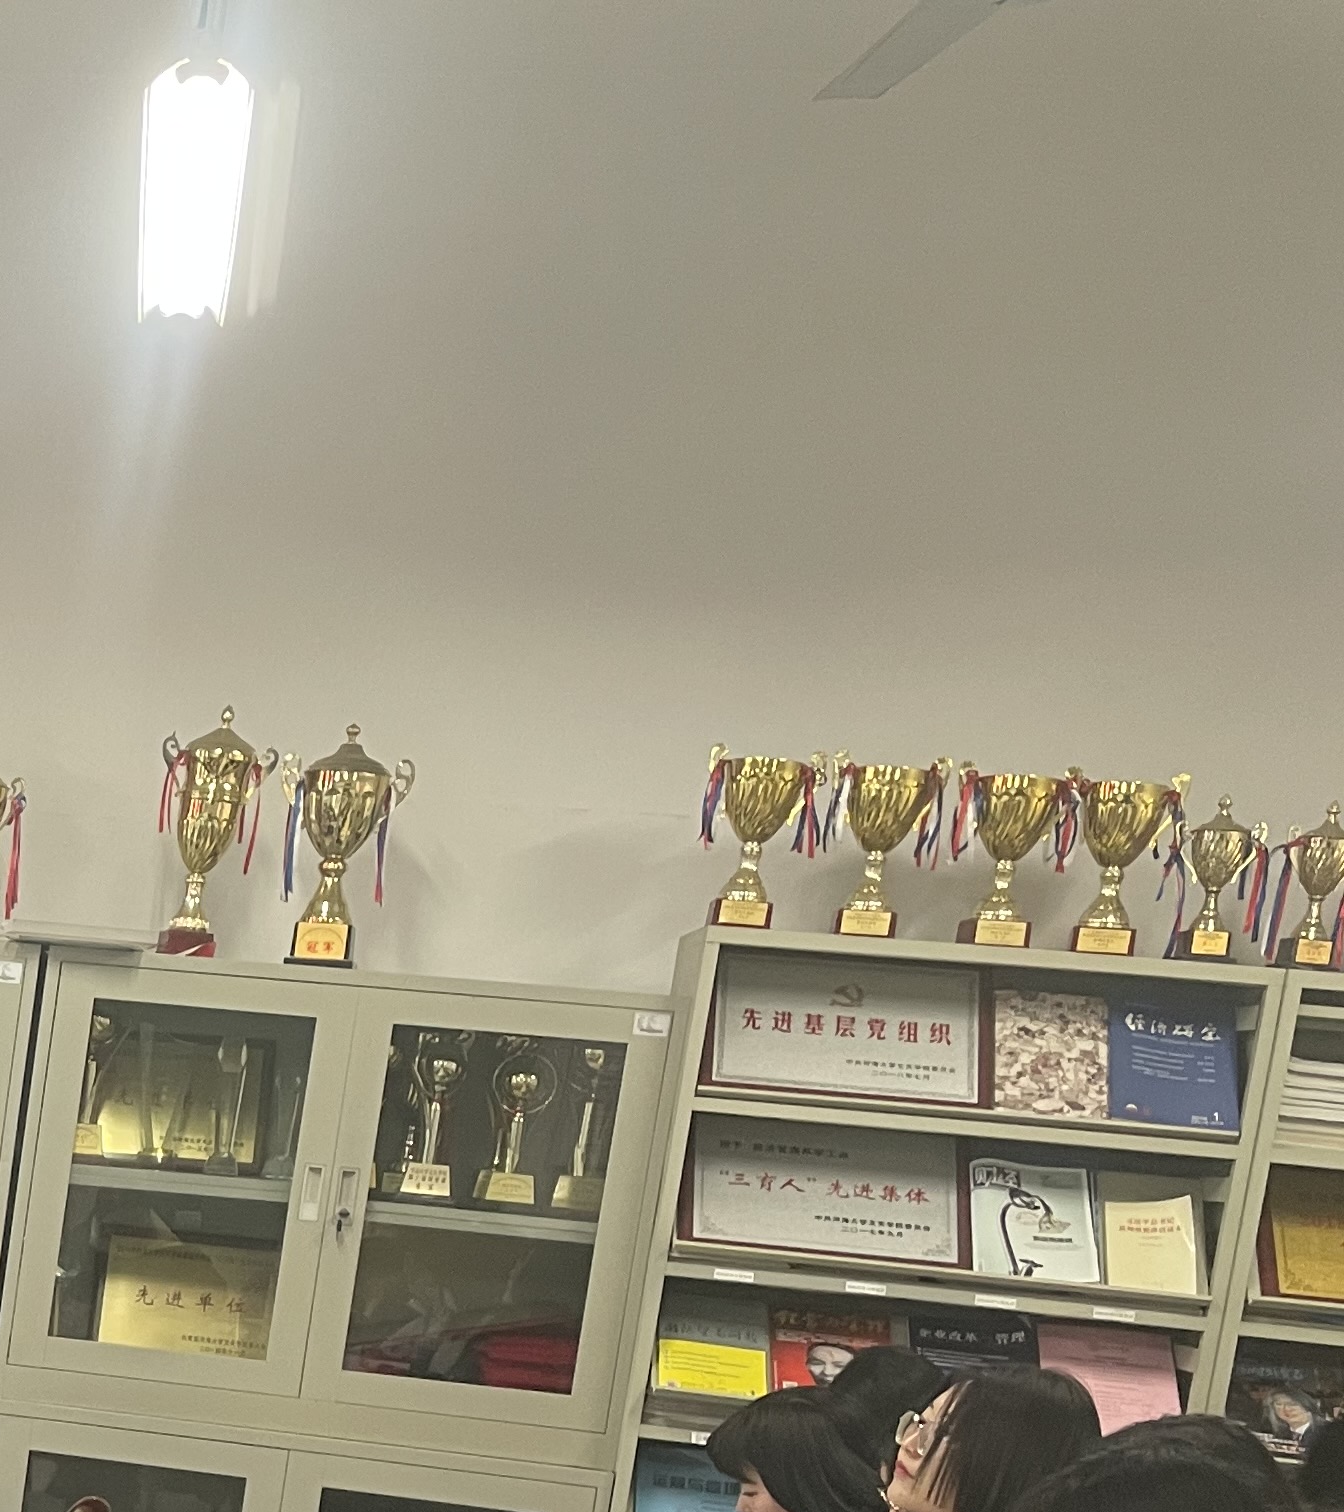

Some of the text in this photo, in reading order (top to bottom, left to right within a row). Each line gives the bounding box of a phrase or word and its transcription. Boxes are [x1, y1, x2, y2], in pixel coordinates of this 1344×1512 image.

[742, 1008, 952, 1046] 先进基层党组织
[1213, 1111, 1219, 1122] 1
[135, 1285, 247, 1313] 先进单位
